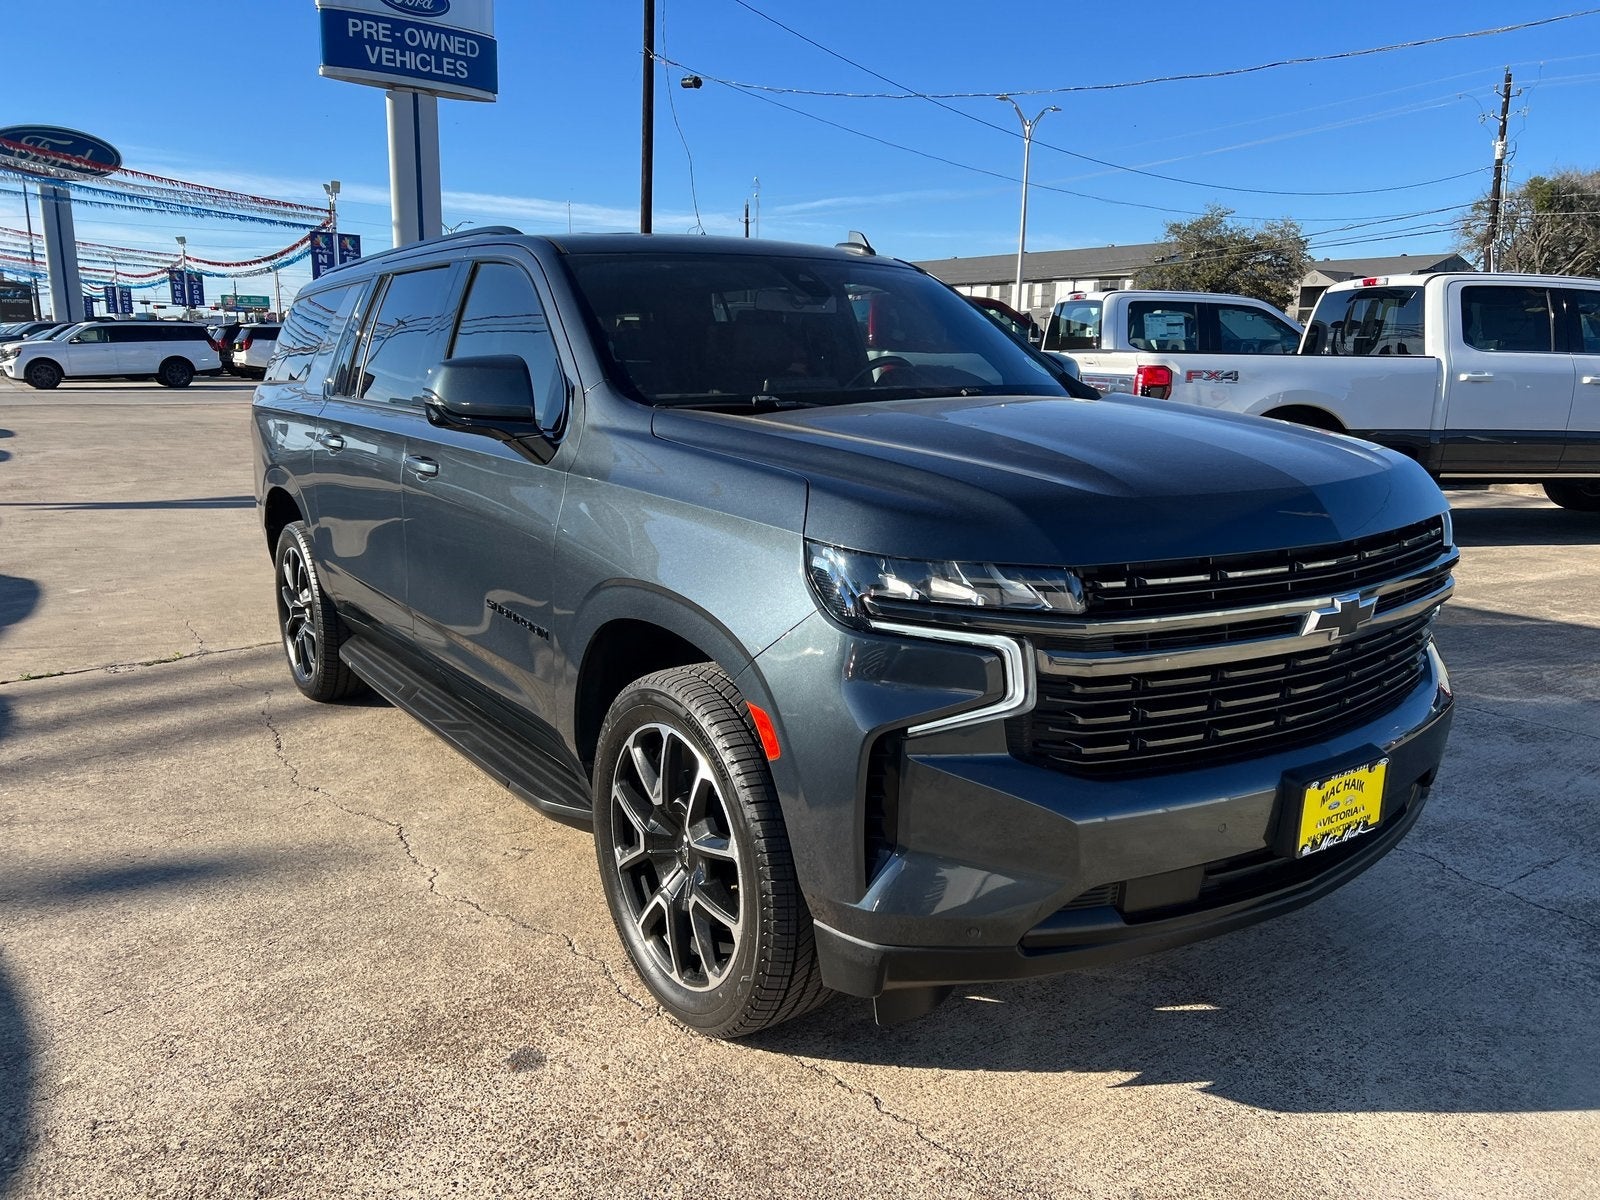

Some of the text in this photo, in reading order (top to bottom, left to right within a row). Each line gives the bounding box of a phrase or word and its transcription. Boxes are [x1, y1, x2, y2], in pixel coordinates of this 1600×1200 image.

[365, 44, 468, 79] VEHICLES
[174, 284, 183, 304] NEW
[192, 284, 201, 305] FORD
[1185, 369, 1239, 383] FX4
[486, 598, 550, 641] SUBURBAN
[1320, 781, 1342, 808] MAC
[1343, 778, 1365, 793] HAIK
[1322, 806, 1359, 827] VICTORIA
[1320, 833, 1341, 851] Mac
